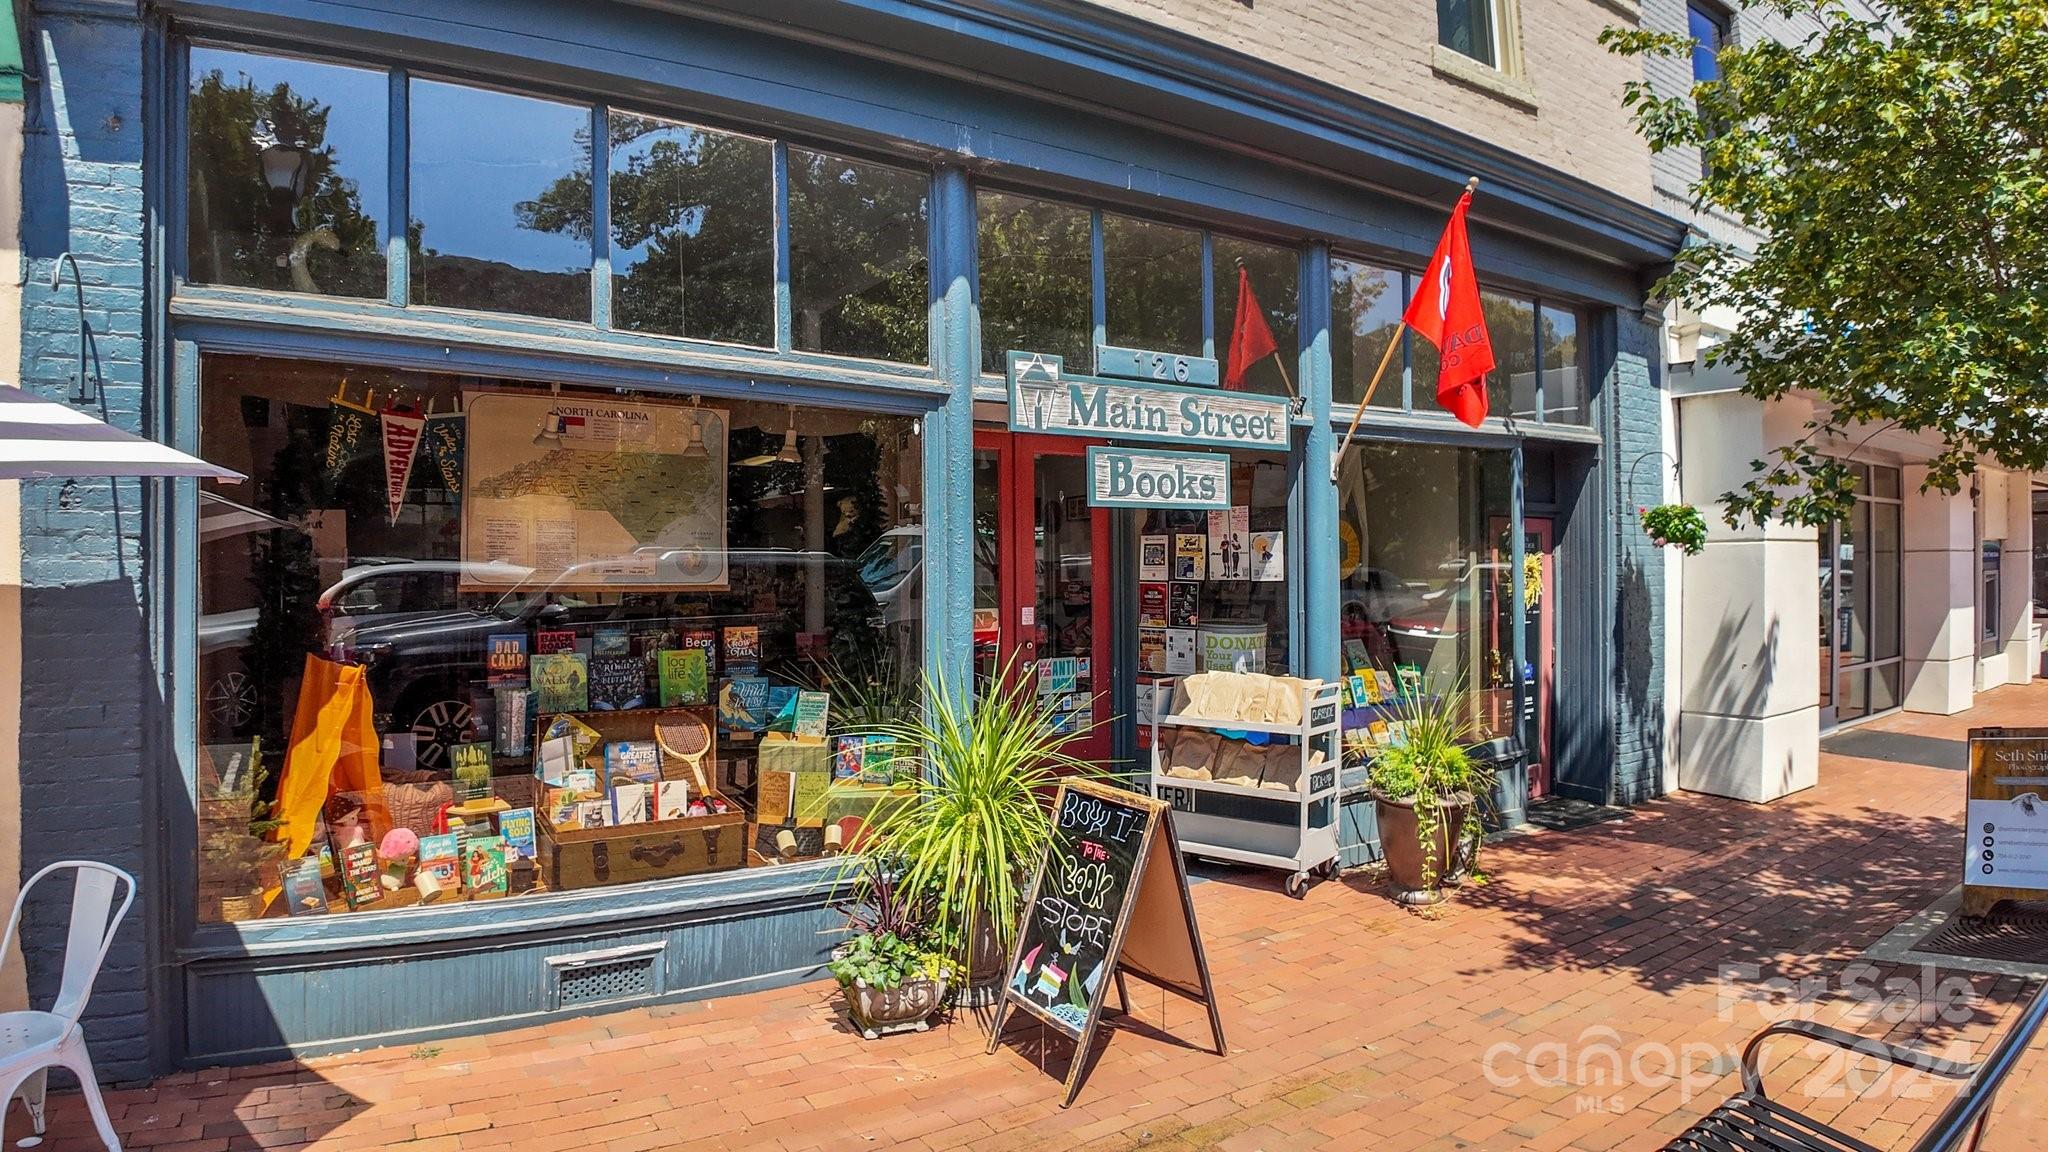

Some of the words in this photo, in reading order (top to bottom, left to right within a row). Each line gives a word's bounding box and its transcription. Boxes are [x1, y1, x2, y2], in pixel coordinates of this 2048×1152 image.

[1134, 352, 1189, 383] 126
[556, 406, 593, 417] NORTH
[596, 409, 649, 421] CAROLINA
[1067, 384, 1168, 432] Main
[1180, 397, 1276, 440] Street
[386, 420, 418, 498] ADVENTURE
[1108, 456, 1216, 500] Books
[540, 633, 574, 643] BACK
[685, 638, 712, 648] Bear
[495, 641, 519, 654] DAD
[491, 654, 524, 668] CAMP
[667, 656, 686, 670] log
[1052, 660, 1075, 677] ANTI
[668, 668, 686, 680] life
[620, 750, 657, 760] GREATEST
[1995, 749, 2025, 762] Seth
[2027, 750, 2048, 762] Sni
[1061, 792, 1111, 837] BOOK
[501, 817, 530, 829] FLYING
[510, 827, 531, 838] SOLO
[1081, 840, 1093, 857] TO
[1093, 843, 1107, 860] THE
[473, 865, 509, 889] Catch
[1061, 855, 1114, 909] BOOK
[1041, 897, 1112, 949] STORE
